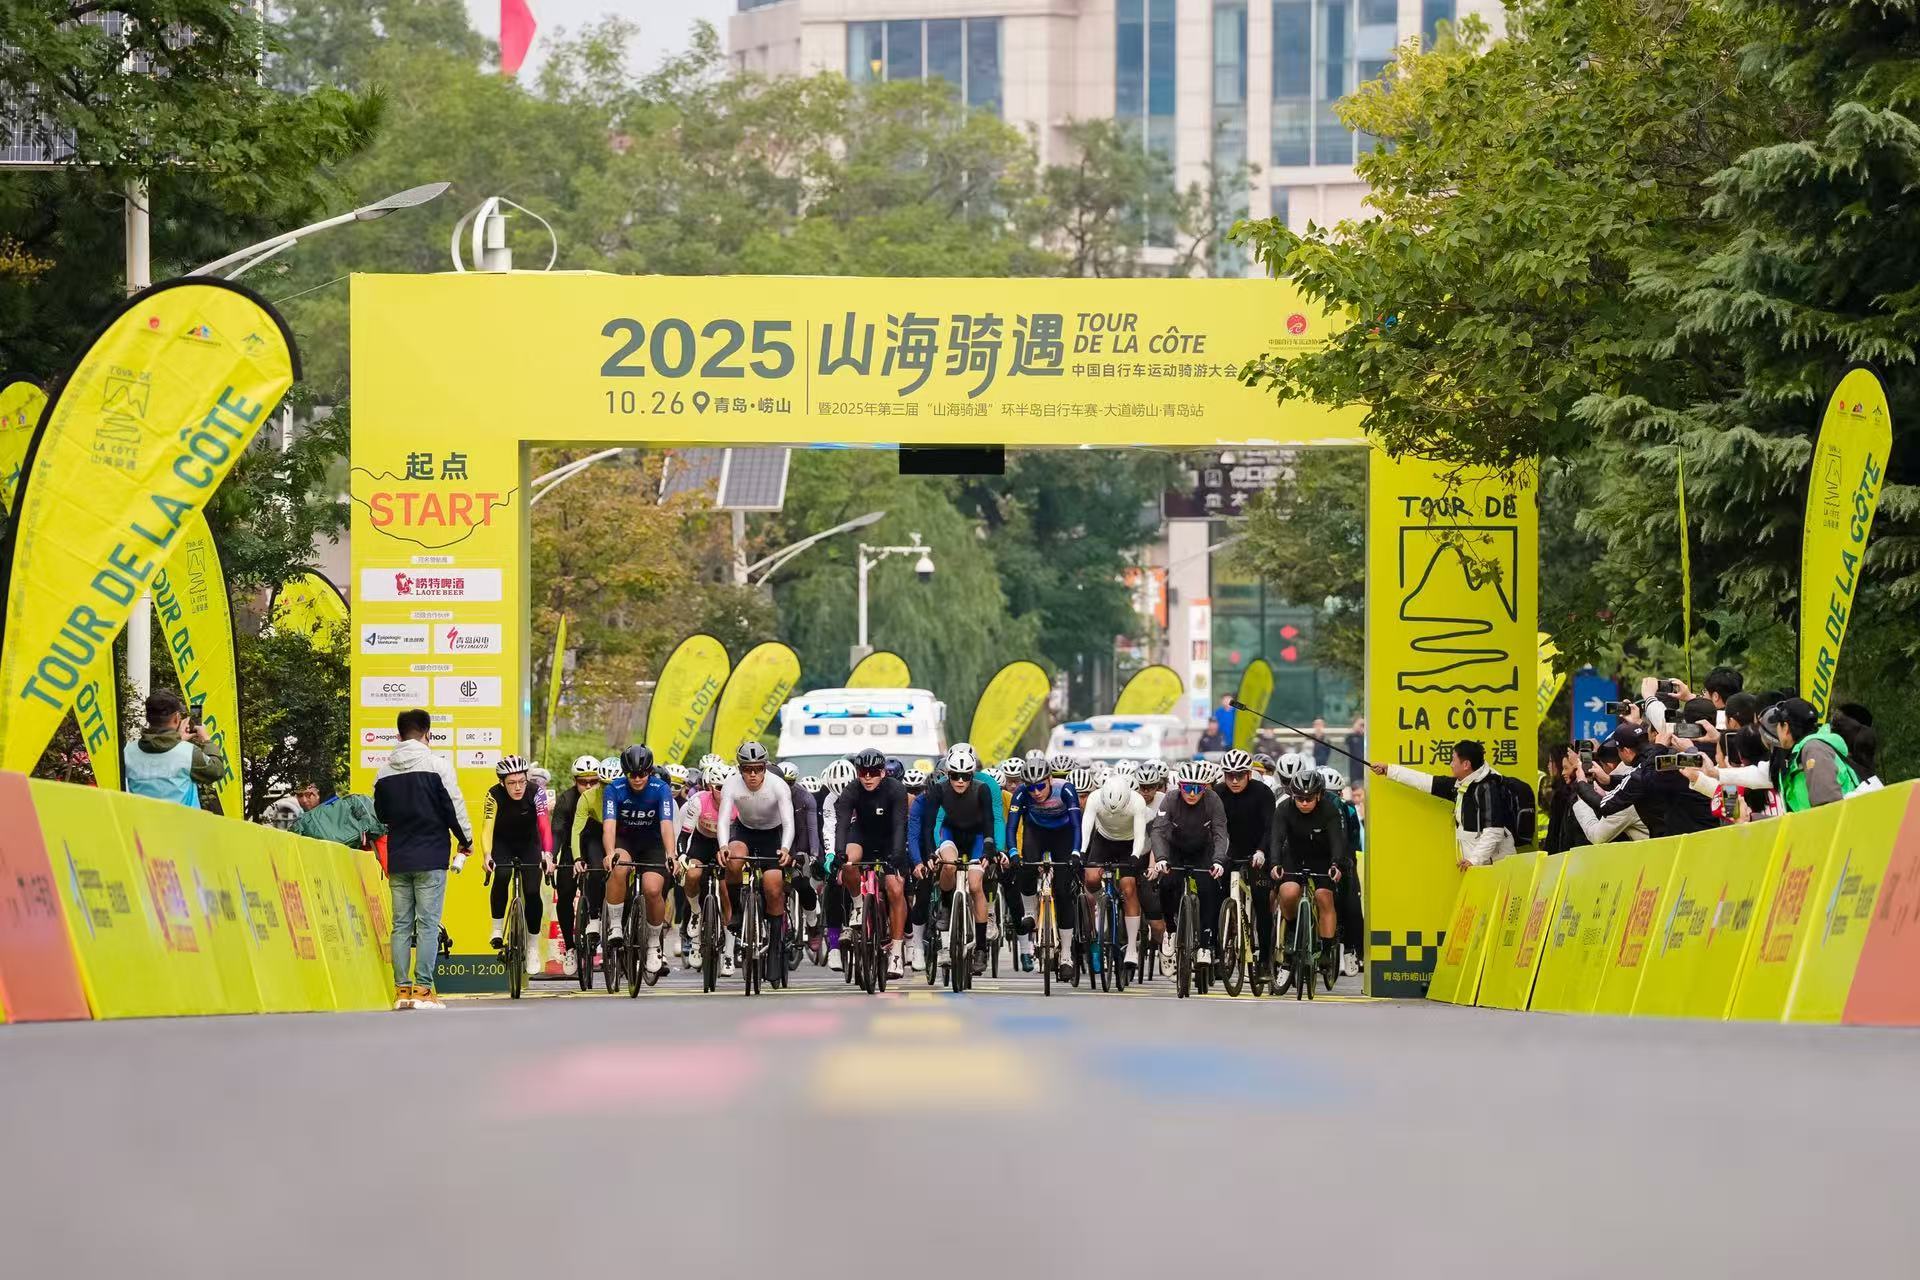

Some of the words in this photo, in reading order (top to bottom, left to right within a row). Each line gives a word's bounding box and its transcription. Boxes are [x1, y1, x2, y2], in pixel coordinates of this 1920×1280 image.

[1077, 312, 1138, 333] TOUR
[600, 317, 795, 379] 2025
[817, 310, 1065, 400] 山海骑遇
[1073, 334, 1102, 354] DE
[1112, 334, 1140, 354] LA
[1149, 325, 1207, 354] CÔTE
[1071, 363, 1238, 379] 中国自行车运动骑游大会
[604, 390, 685, 415] 10.26
[713, 396, 792, 415] 青岛·崂山
[405, 451, 469, 481] 起点
[369, 491, 500, 527] START
[1397, 495, 1474, 518] TOUR
[1485, 495, 1518, 518] DE
[1850, 451, 1881, 543] CÔTE
[20, 604, 117, 711] TOUR
[90, 543, 154, 608] DE
[130, 493, 195, 550] LA
[172, 385, 264, 489] CÔTE
[415, 577, 465, 590] 崂特啤酒
[1835, 549, 1858, 597] LA
[151, 567, 181, 629] OUR
[171, 626, 195, 674] DE
[1825, 592, 1847, 647] DE
[1810, 644, 1836, 719] OUR
[76, 680, 110, 756] ÔTE
[747, 715, 766, 738] LA
[1398, 706, 1430, 731] LA
[1447, 699, 1519, 731] CÔTE
[667, 740, 686, 761] DE
[678, 715, 698, 740] LA
[1399, 739, 1518, 766] 山海遇
[620, 809, 656, 819] ZIBO
